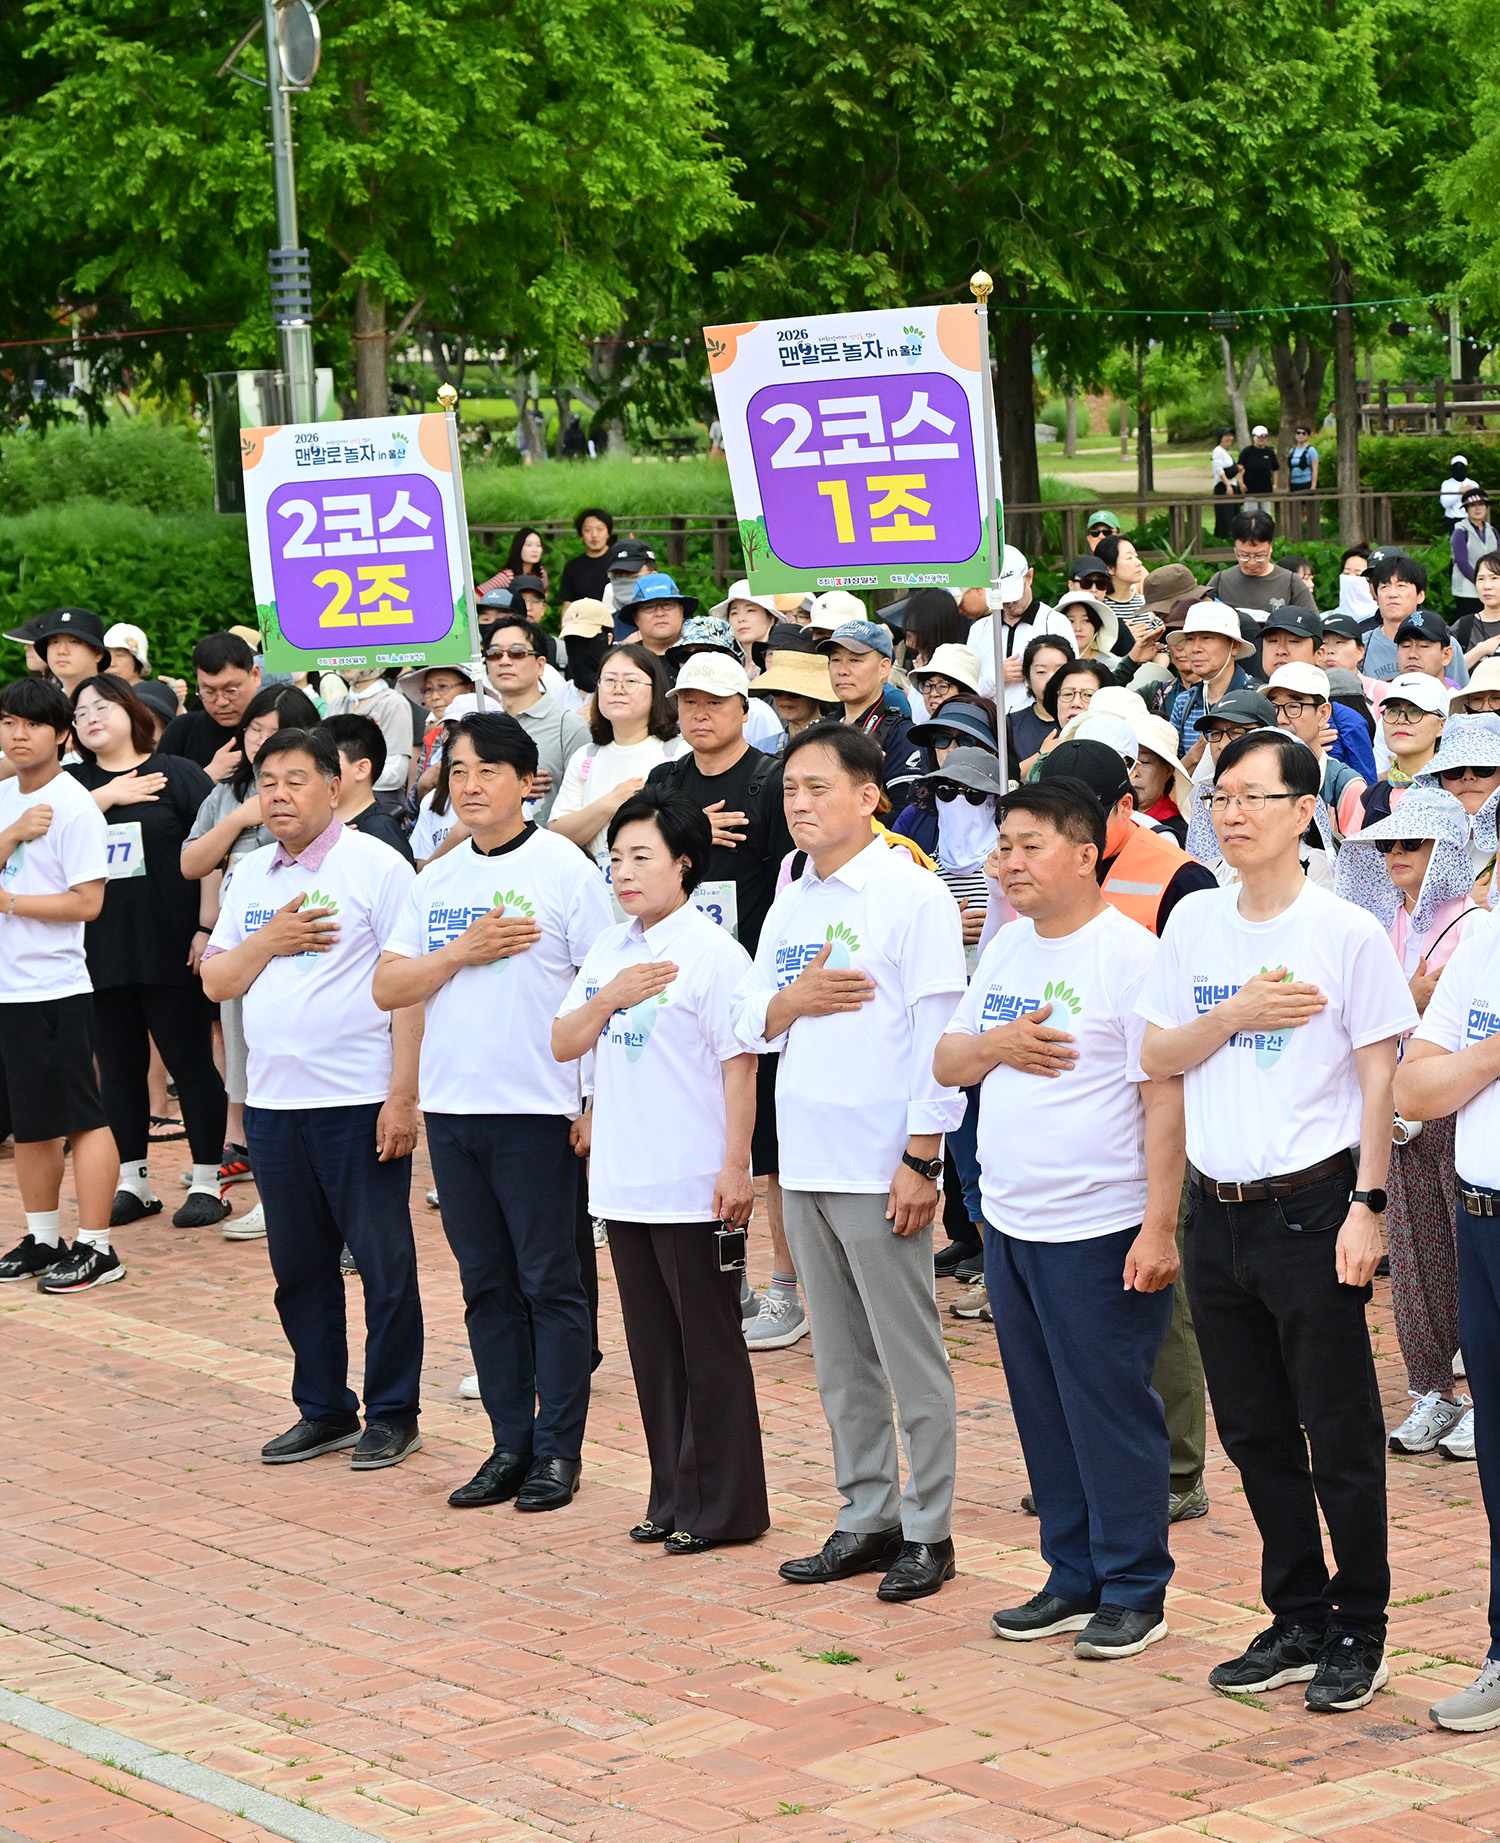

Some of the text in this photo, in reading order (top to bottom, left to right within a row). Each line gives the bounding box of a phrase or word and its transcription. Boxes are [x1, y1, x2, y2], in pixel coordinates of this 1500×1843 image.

[777, 329, 808, 342] 2026
[778, 339, 922, 367] 맨발로 놀자 in 울산
[294, 433, 319, 444] 2026
[761, 391, 959, 469] 2코스
[295, 444, 406, 467] 맨발로 놀자 in 울산
[817, 474, 936, 543] 1조
[277, 490, 434, 559] 2코스
[312, 564, 414, 628] 2조
[1193, 975, 1208, 983] 2026
[1472, 998, 1490, 1009] 2026
[612, 1031, 644, 1046] in 울산
[1239, 1033, 1284, 1052] in 울산
